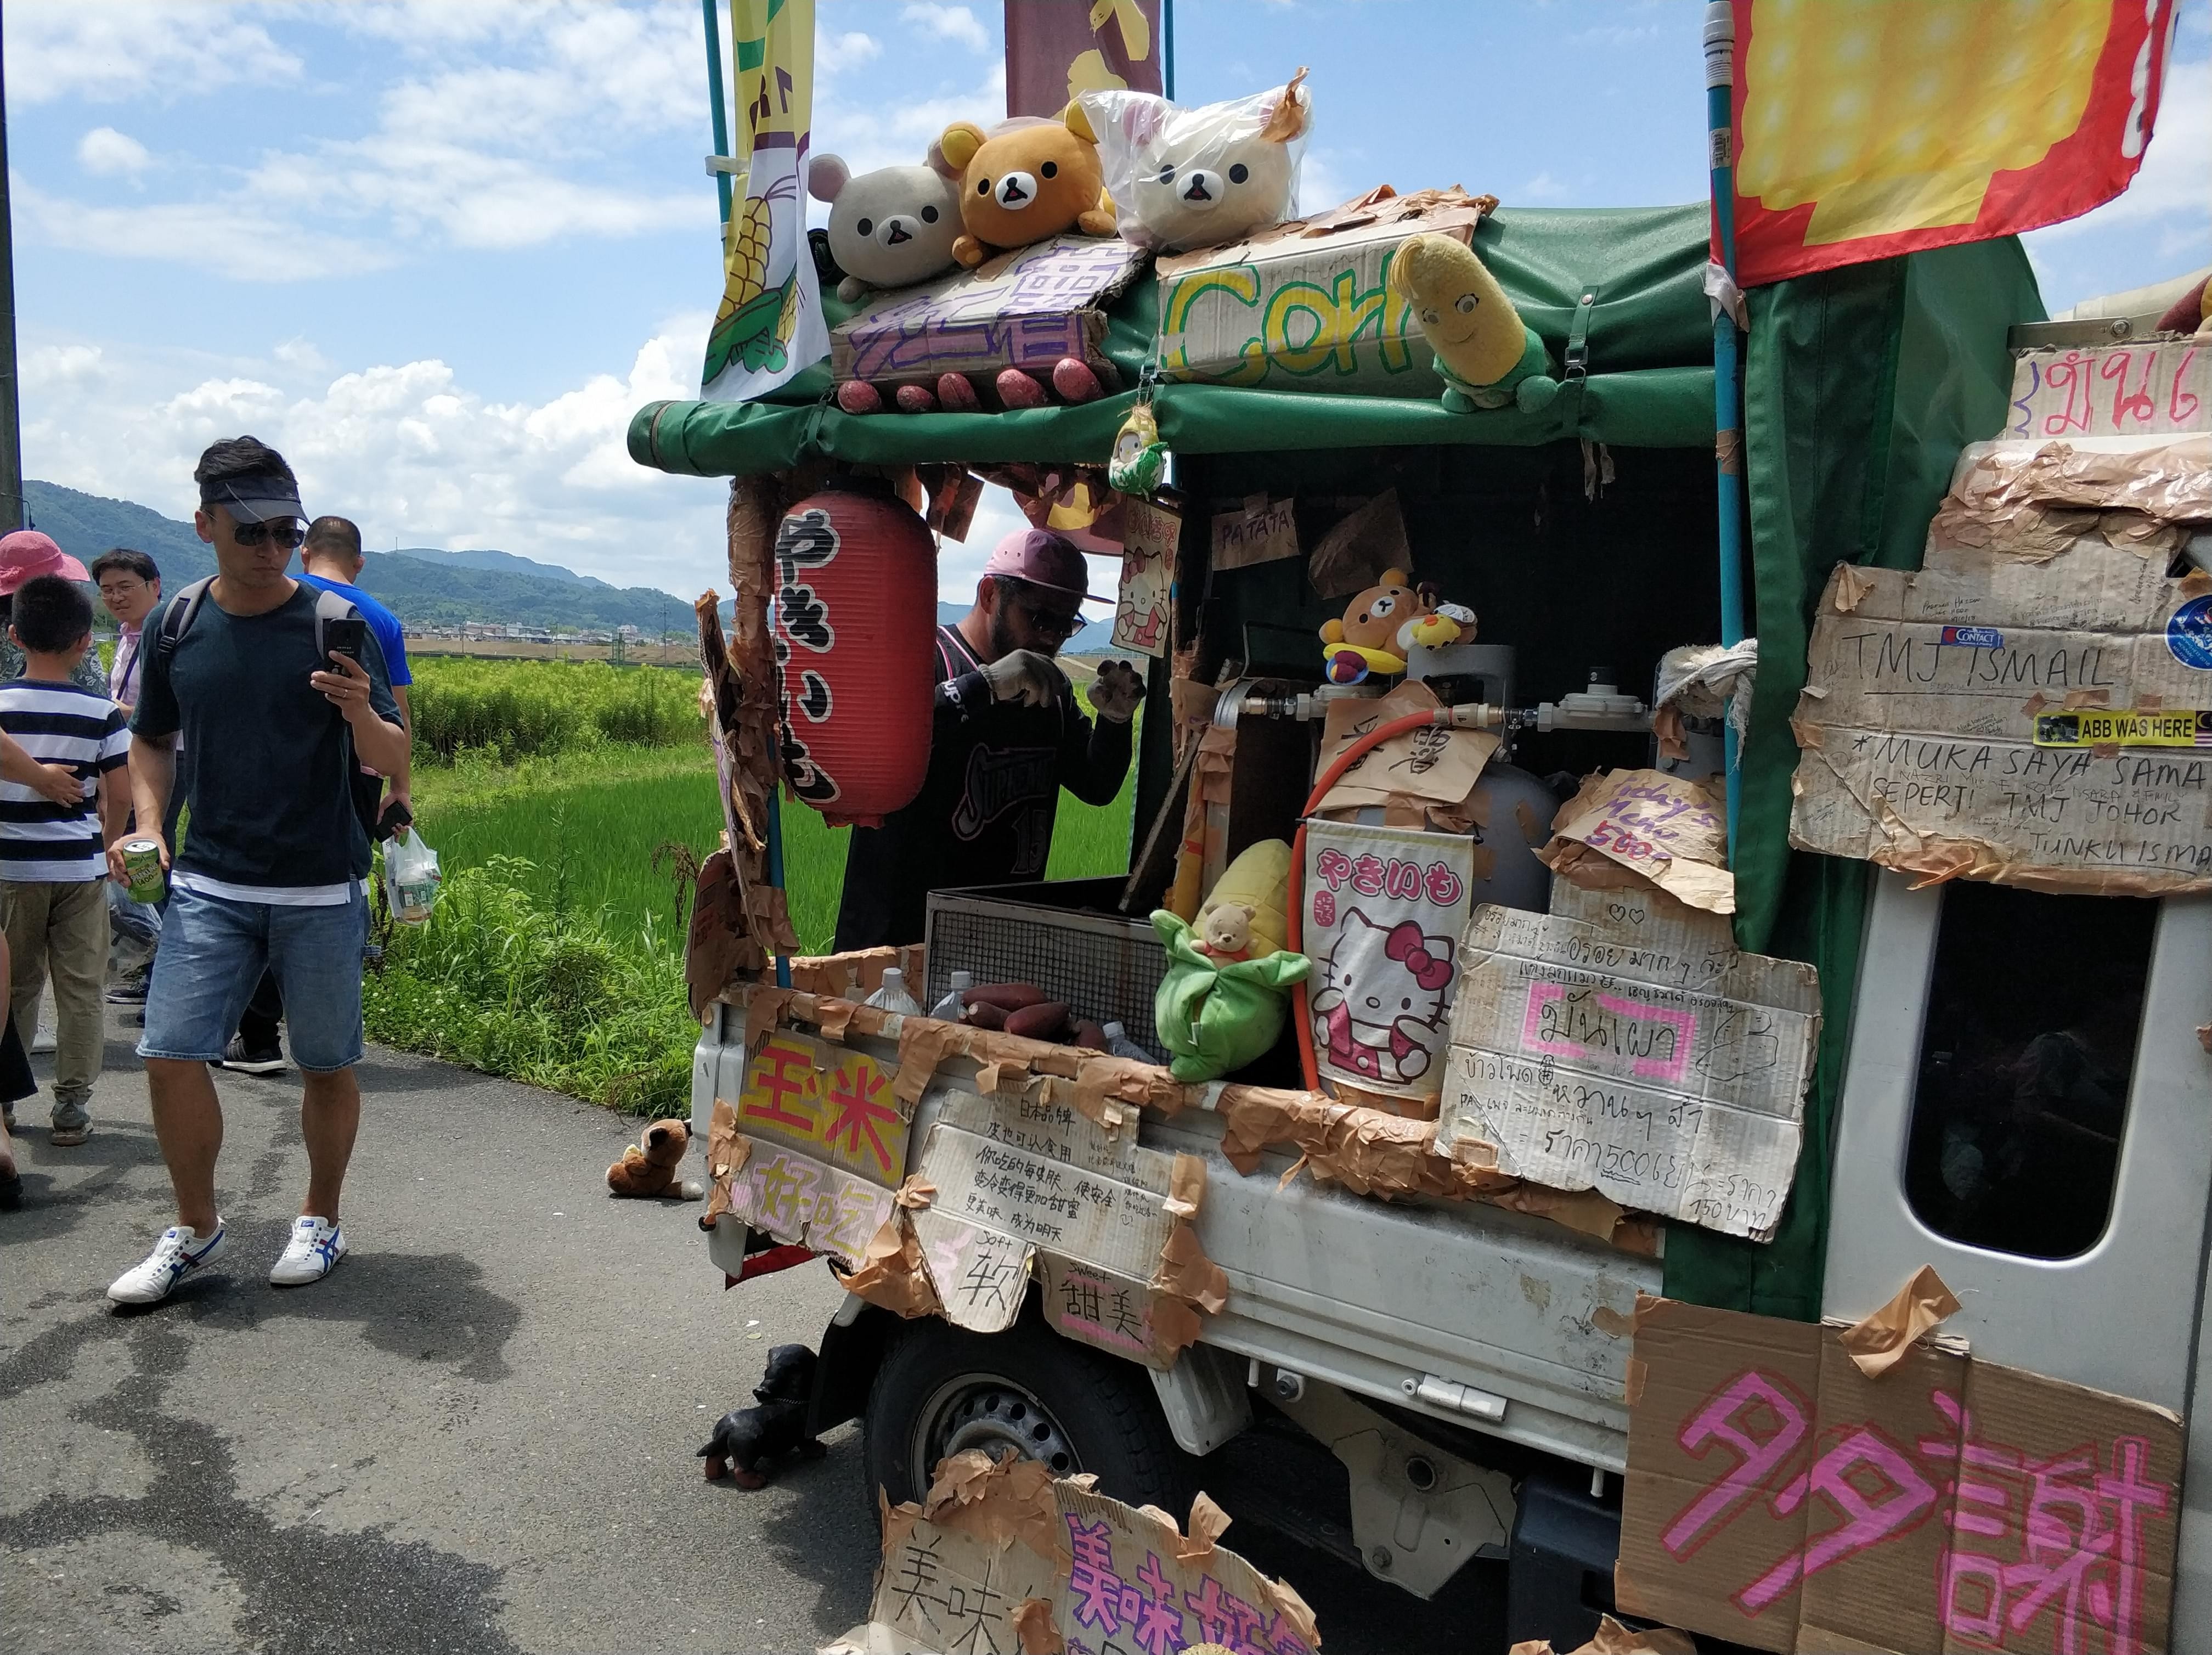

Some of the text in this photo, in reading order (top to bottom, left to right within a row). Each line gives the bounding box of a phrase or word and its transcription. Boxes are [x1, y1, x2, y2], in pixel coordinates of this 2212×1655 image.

[1842, 632, 1942, 684] TMJ
[1967, 646, 2115, 686] ISMAIL
[1956, 629, 1994, 642] CONTACT
[2081, 718, 2192, 739] ABB WAS HERE
[2006, 750, 2092, 784] SAYA
[2111, 756, 2206, 790] SAMA
[2004, 792, 2070, 824] TMJ
[2085, 799, 2181, 825] JOHOR
[2029, 832, 2124, 862] TUNKU
[1316, 847, 1464, 908] やきいも
[1540, 989, 1676, 1063] มันเผา
[745, 1046, 899, 1172] 玉米
[1020, 1097, 1076, 1136] 日本品牌
[757, 1157, 876, 1259] 好吃
[1059, 1279, 1144, 1343] 甜美
[890, 1525, 1053, 1655] 美味
